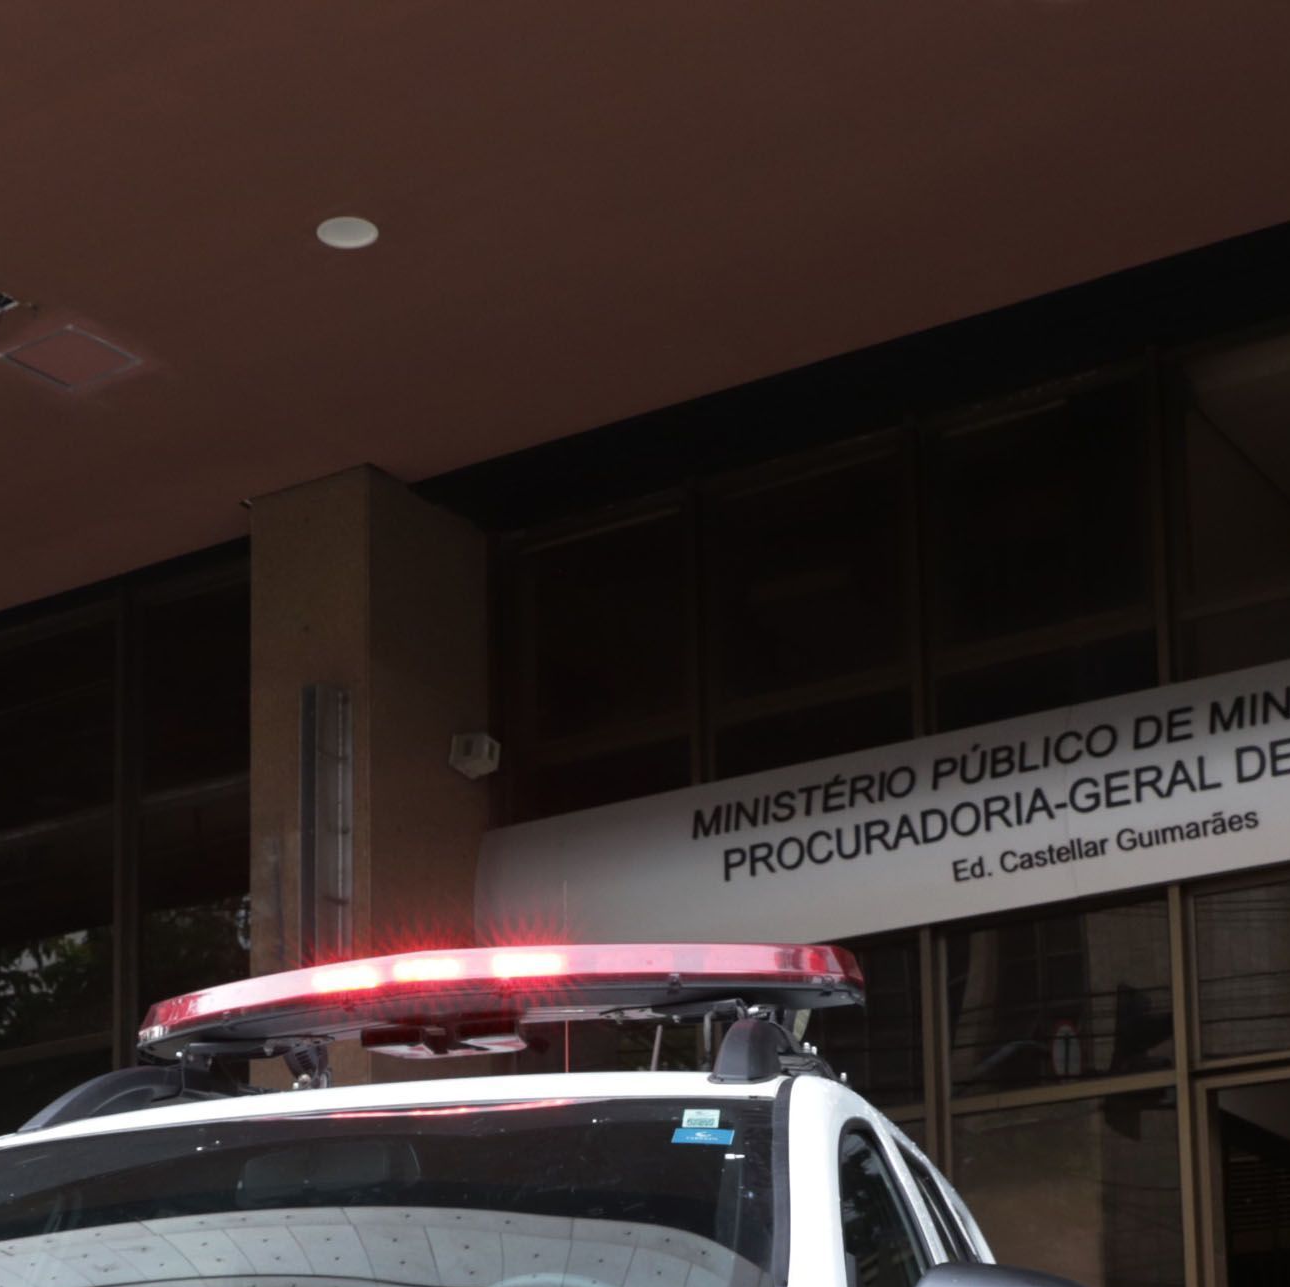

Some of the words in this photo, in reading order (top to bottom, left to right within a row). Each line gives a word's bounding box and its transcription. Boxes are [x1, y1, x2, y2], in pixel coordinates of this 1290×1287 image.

[691, 765, 917, 841] MINISTÉRIO
[931, 723, 1119, 791] PÚBLICO
[1132, 705, 1195, 750] DE
[722, 755, 1222, 883] PROCURADORIA-GERAL
[951, 855, 994, 883] Ed.
[999, 836, 1110, 875] Castellar
[1116, 810, 1260, 853] Guimarães
